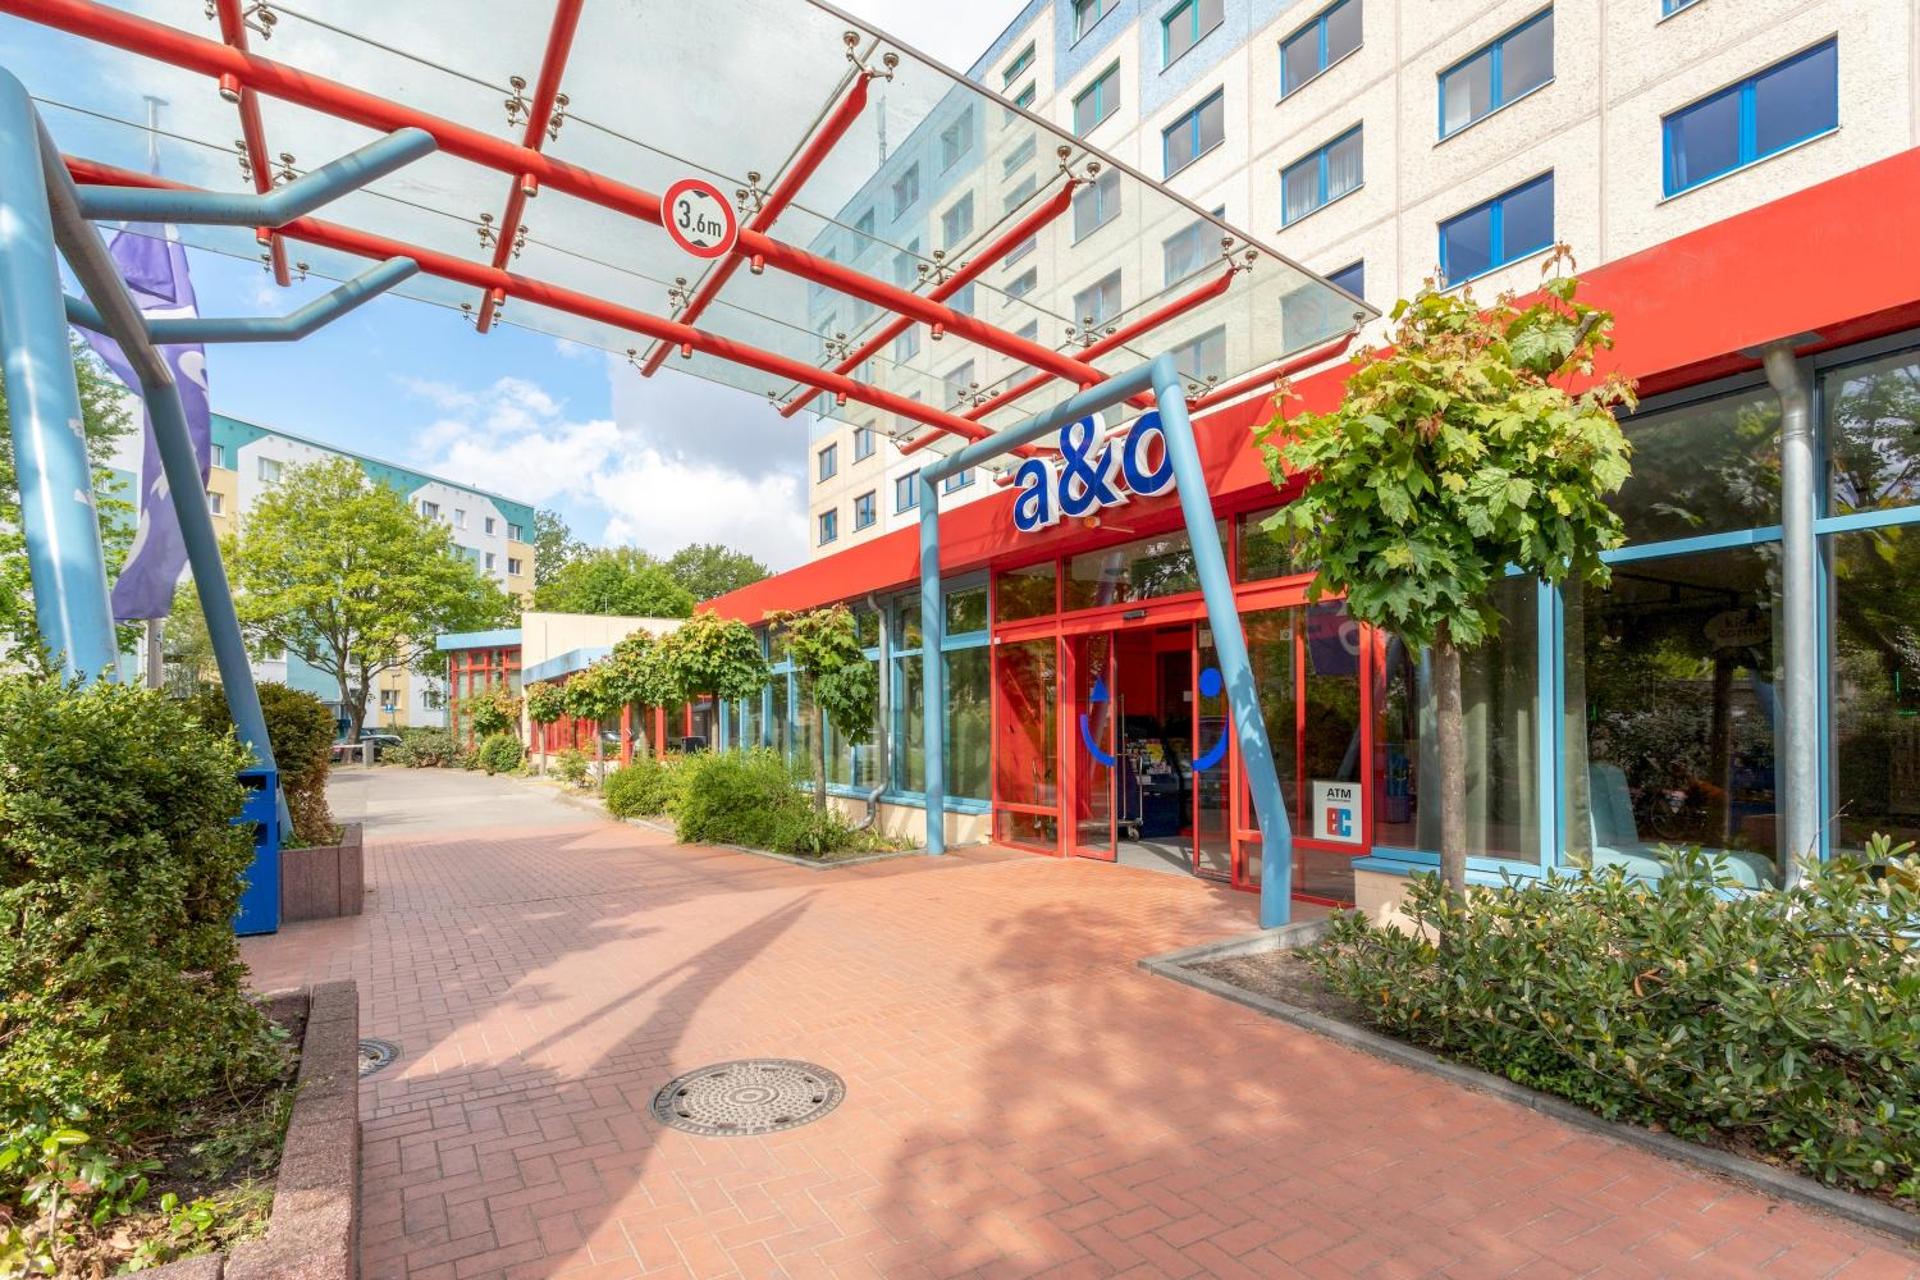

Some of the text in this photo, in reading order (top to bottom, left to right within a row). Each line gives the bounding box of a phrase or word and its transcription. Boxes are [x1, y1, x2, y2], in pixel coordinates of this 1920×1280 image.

[678, 199, 721, 237] 3.6m
[1014, 409, 1176, 532] a&o
[1326, 787, 1352, 799] ATM
